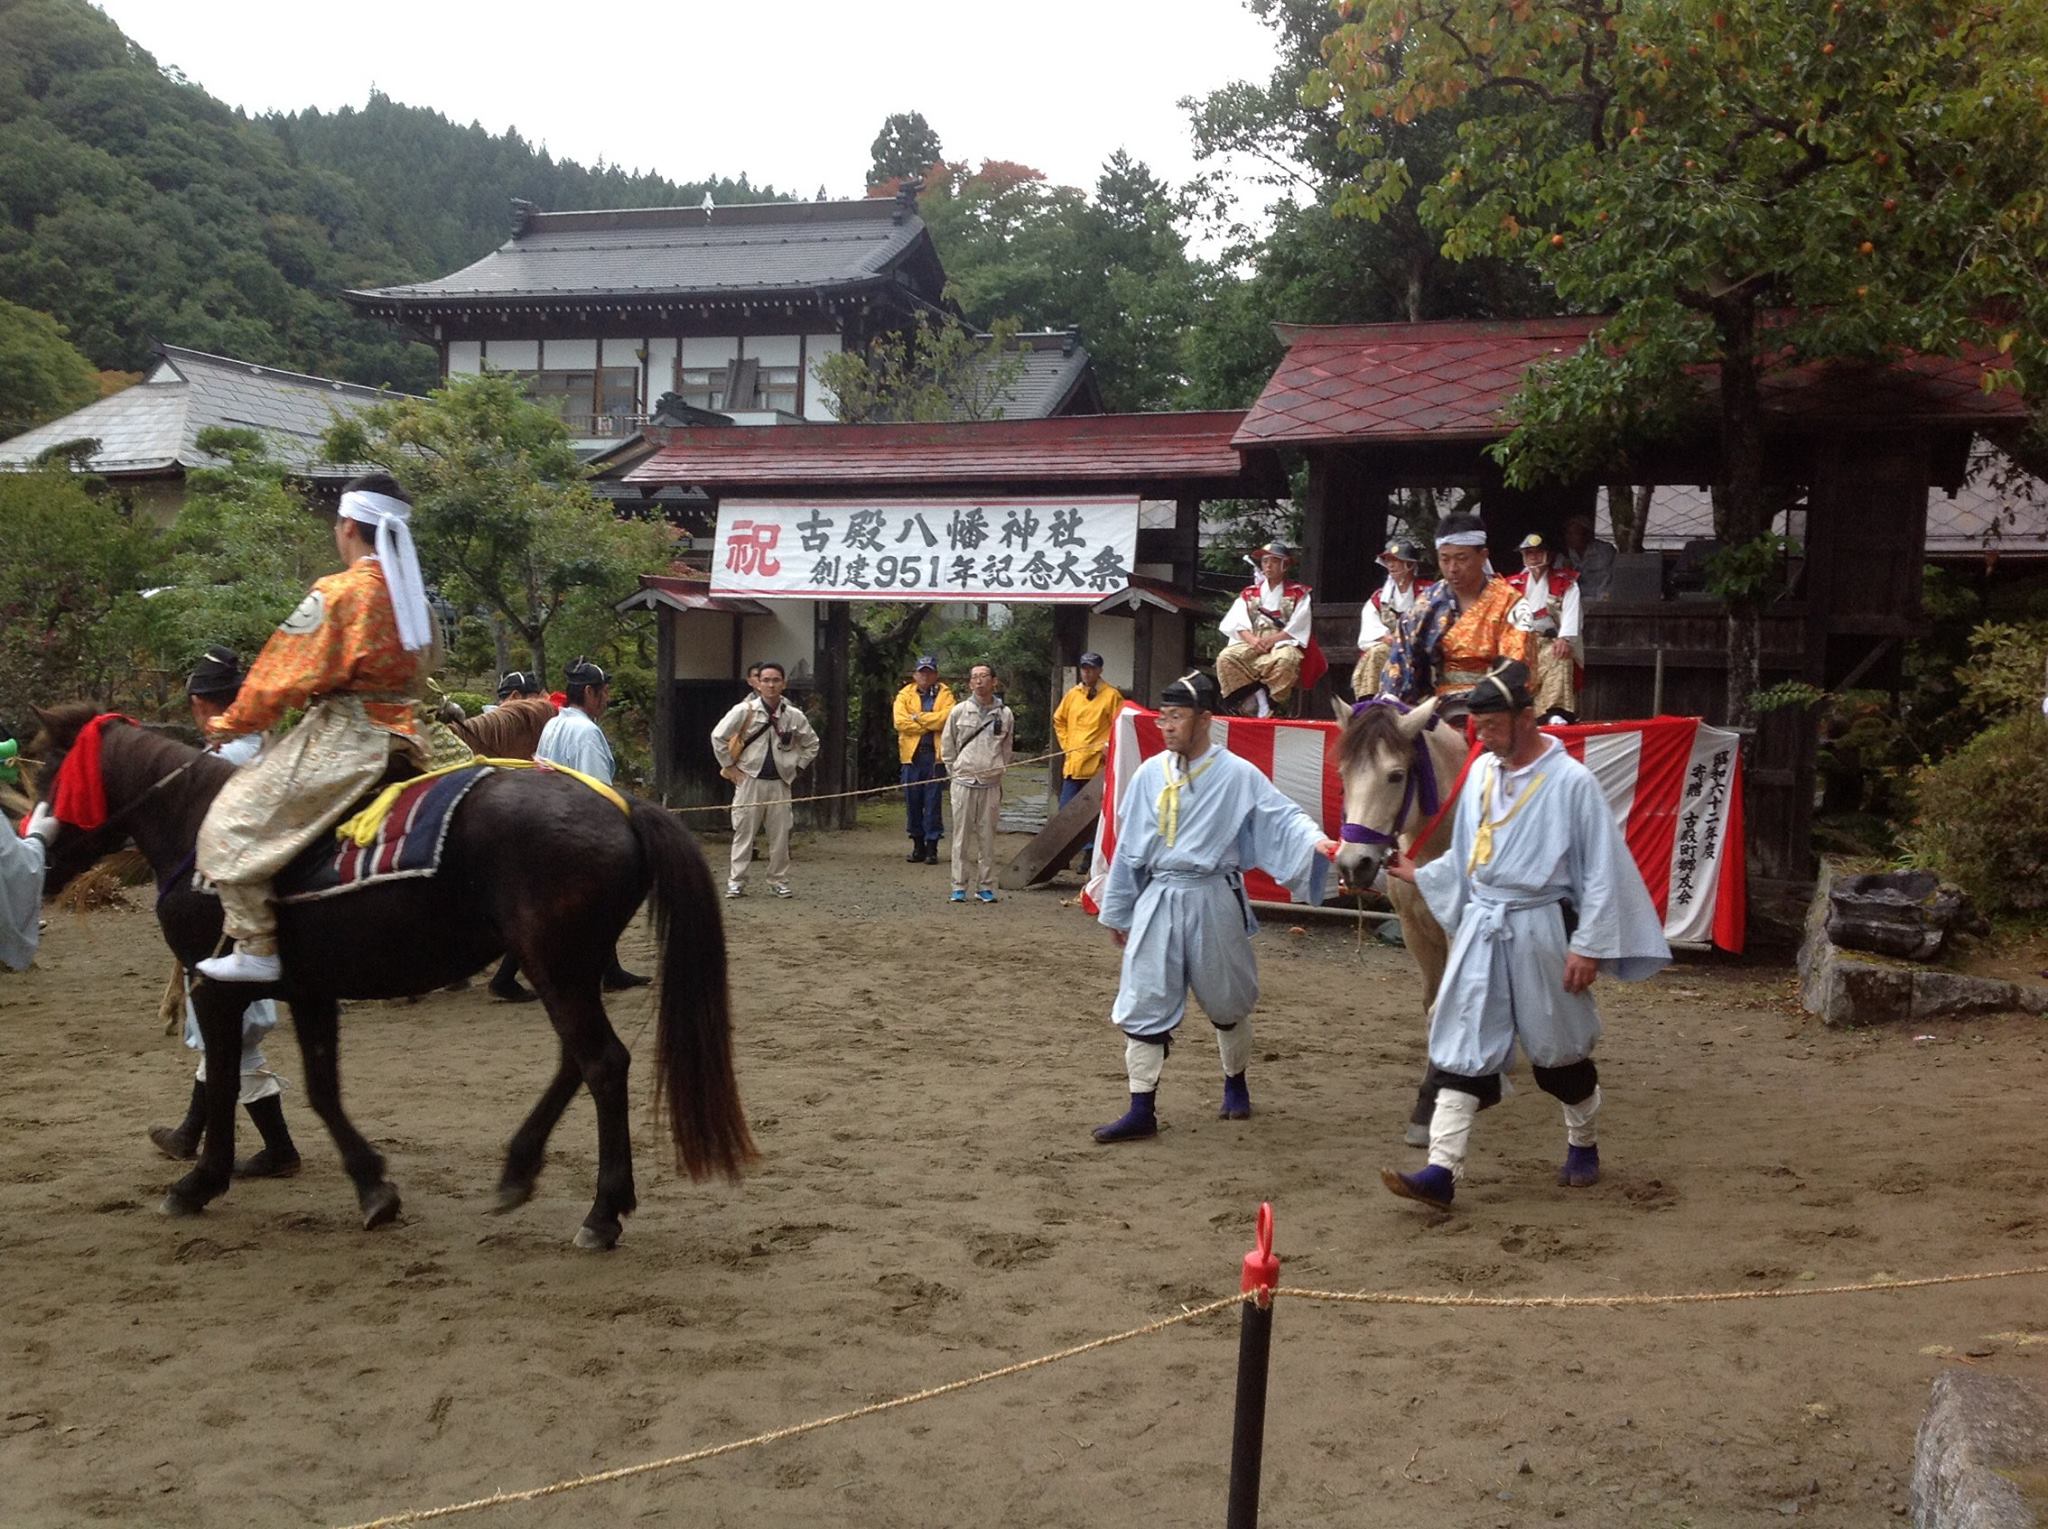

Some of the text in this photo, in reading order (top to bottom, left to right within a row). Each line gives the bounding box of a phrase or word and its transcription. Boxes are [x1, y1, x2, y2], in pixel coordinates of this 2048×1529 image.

[725, 519, 781, 577] 祝
[796, 508, 1087, 553] 古殿八幡神社
[809, 546, 1129, 592] 創建951年記念大祭
[1686, 763, 1706, 798] 寄贈
[1701, 750, 1730, 860] 昭和六十二年度
